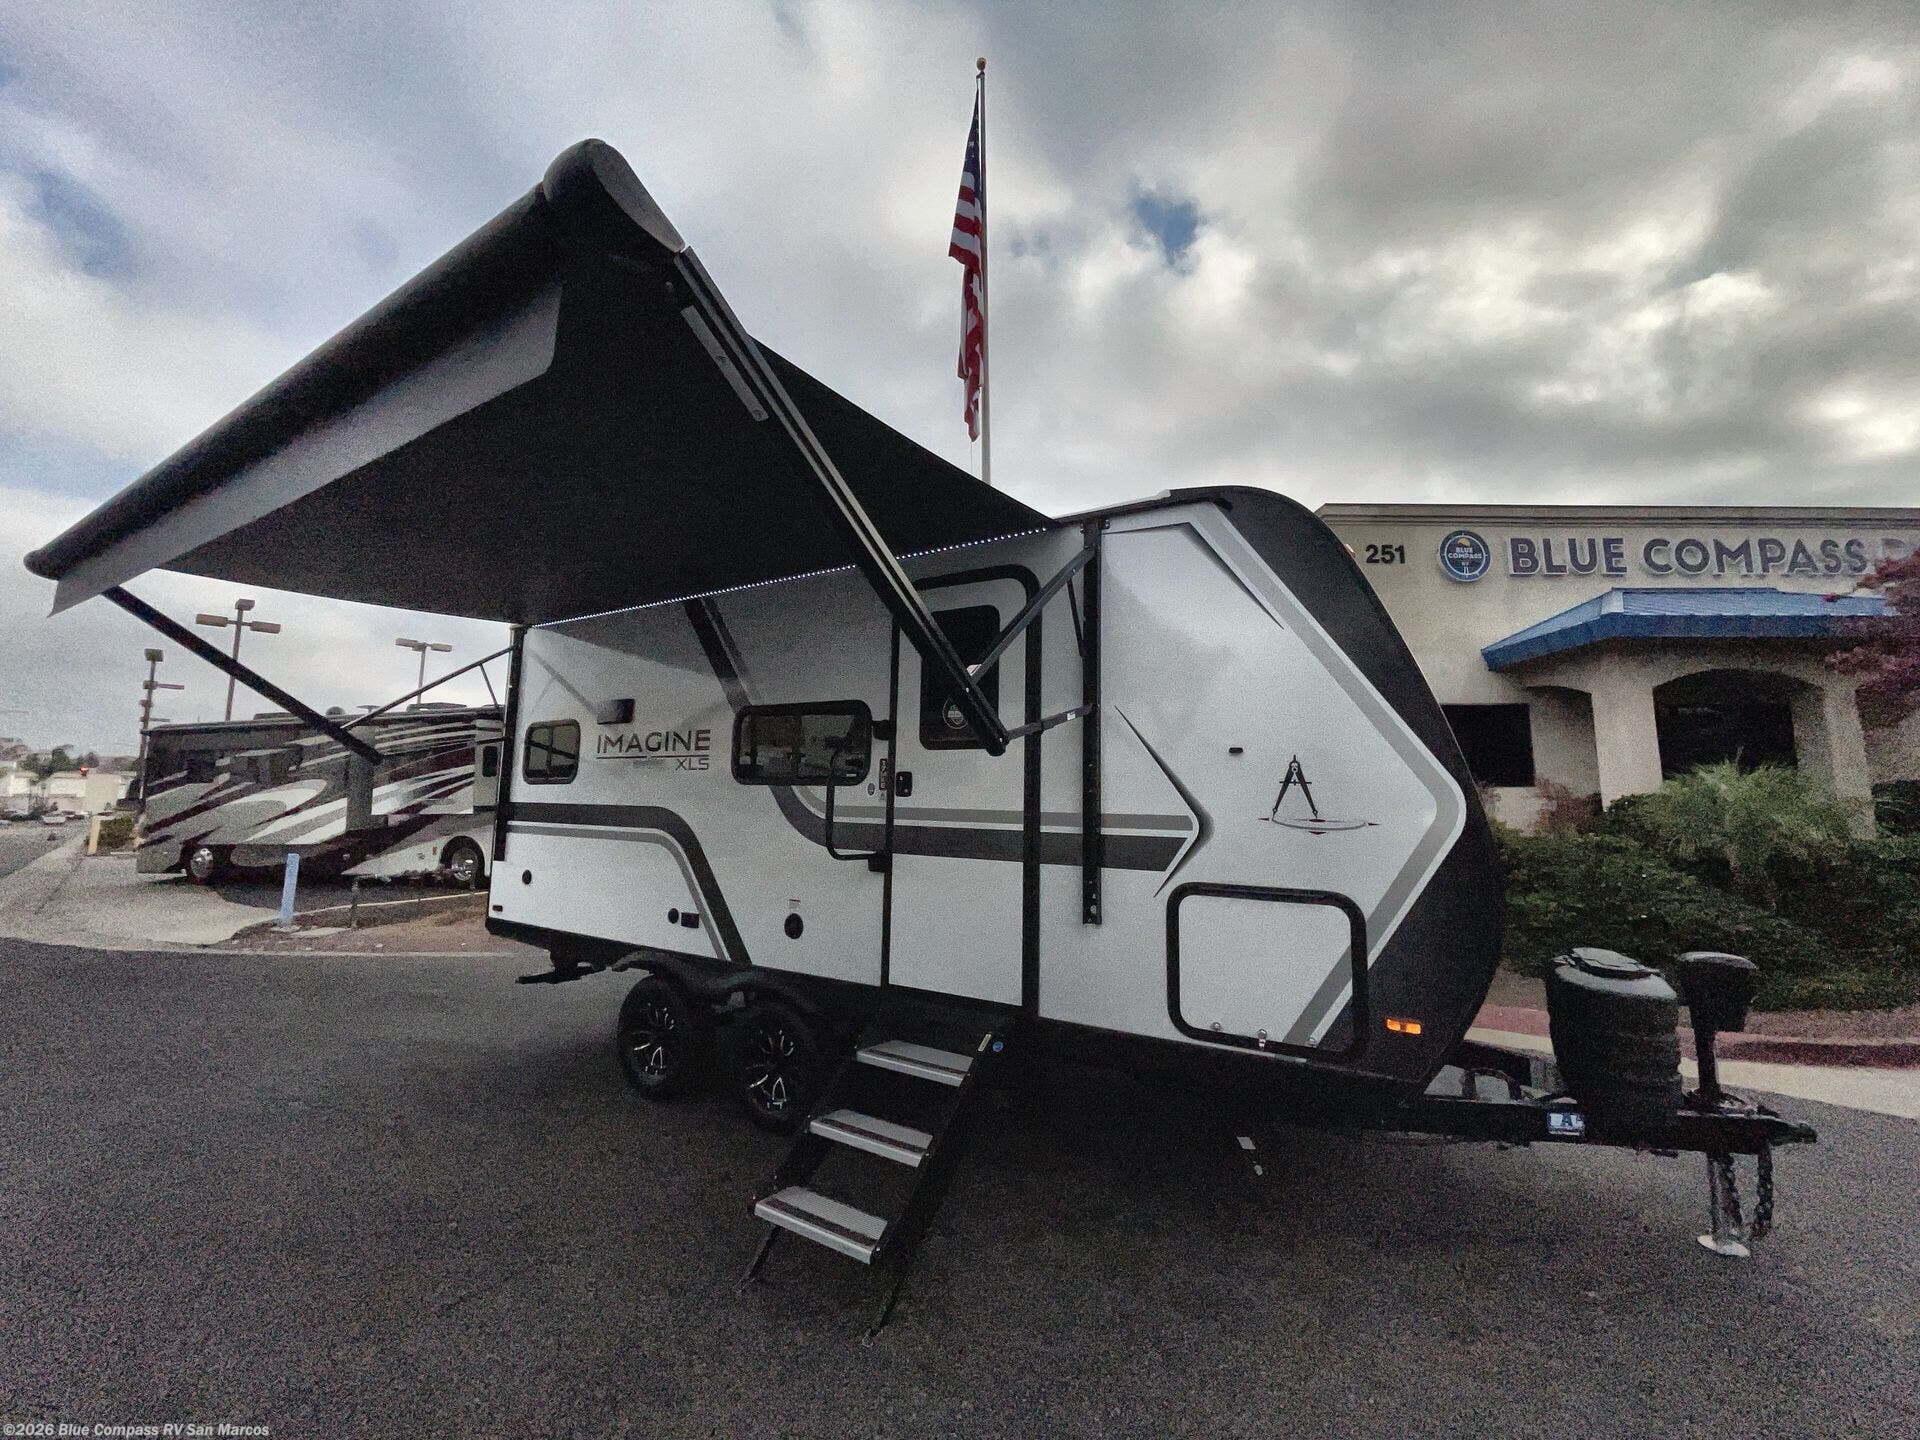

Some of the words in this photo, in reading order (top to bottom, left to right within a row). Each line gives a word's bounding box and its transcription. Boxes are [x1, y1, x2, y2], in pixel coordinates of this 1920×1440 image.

[1365, 543, 1406, 564] 251
[1509, 537, 1628, 574] BLUE
[1642, 537, 1870, 574] COMPASS
[597, 729, 711, 754] IMAGINE
[675, 757, 710, 771] XLS
